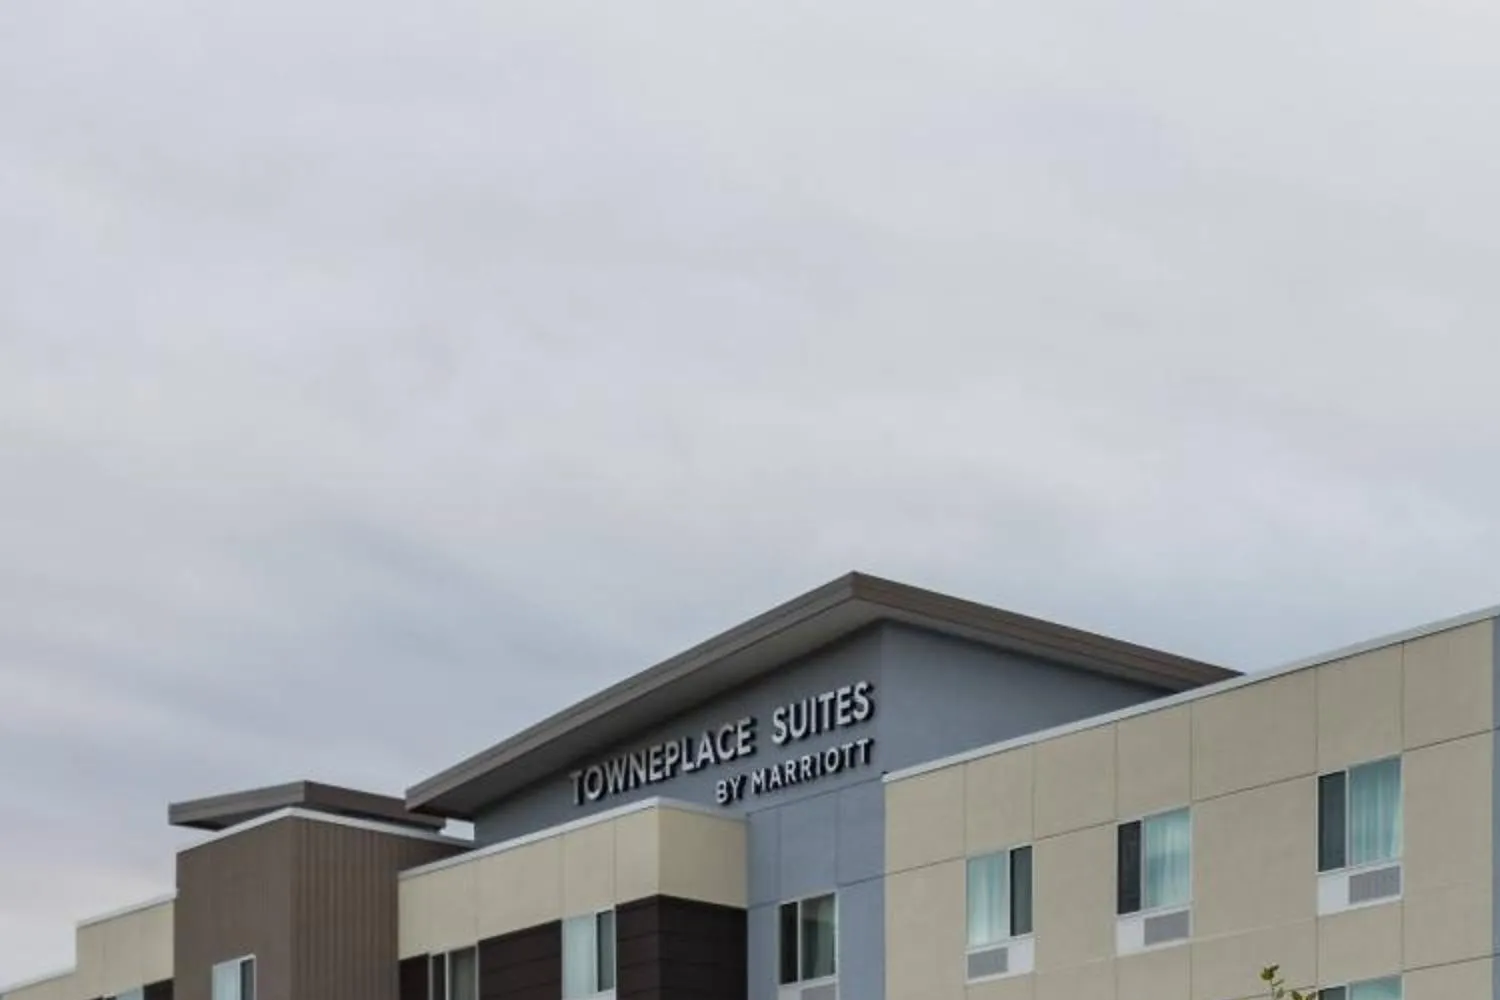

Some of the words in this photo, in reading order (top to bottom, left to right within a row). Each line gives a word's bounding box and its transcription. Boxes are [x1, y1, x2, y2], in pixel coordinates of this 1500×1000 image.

[569, 718, 754, 804] TOWNEPLACE
[771, 680, 873, 745] SUITES
[716, 773, 744, 803] BY
[750, 737, 873, 795] MARRIOTT
